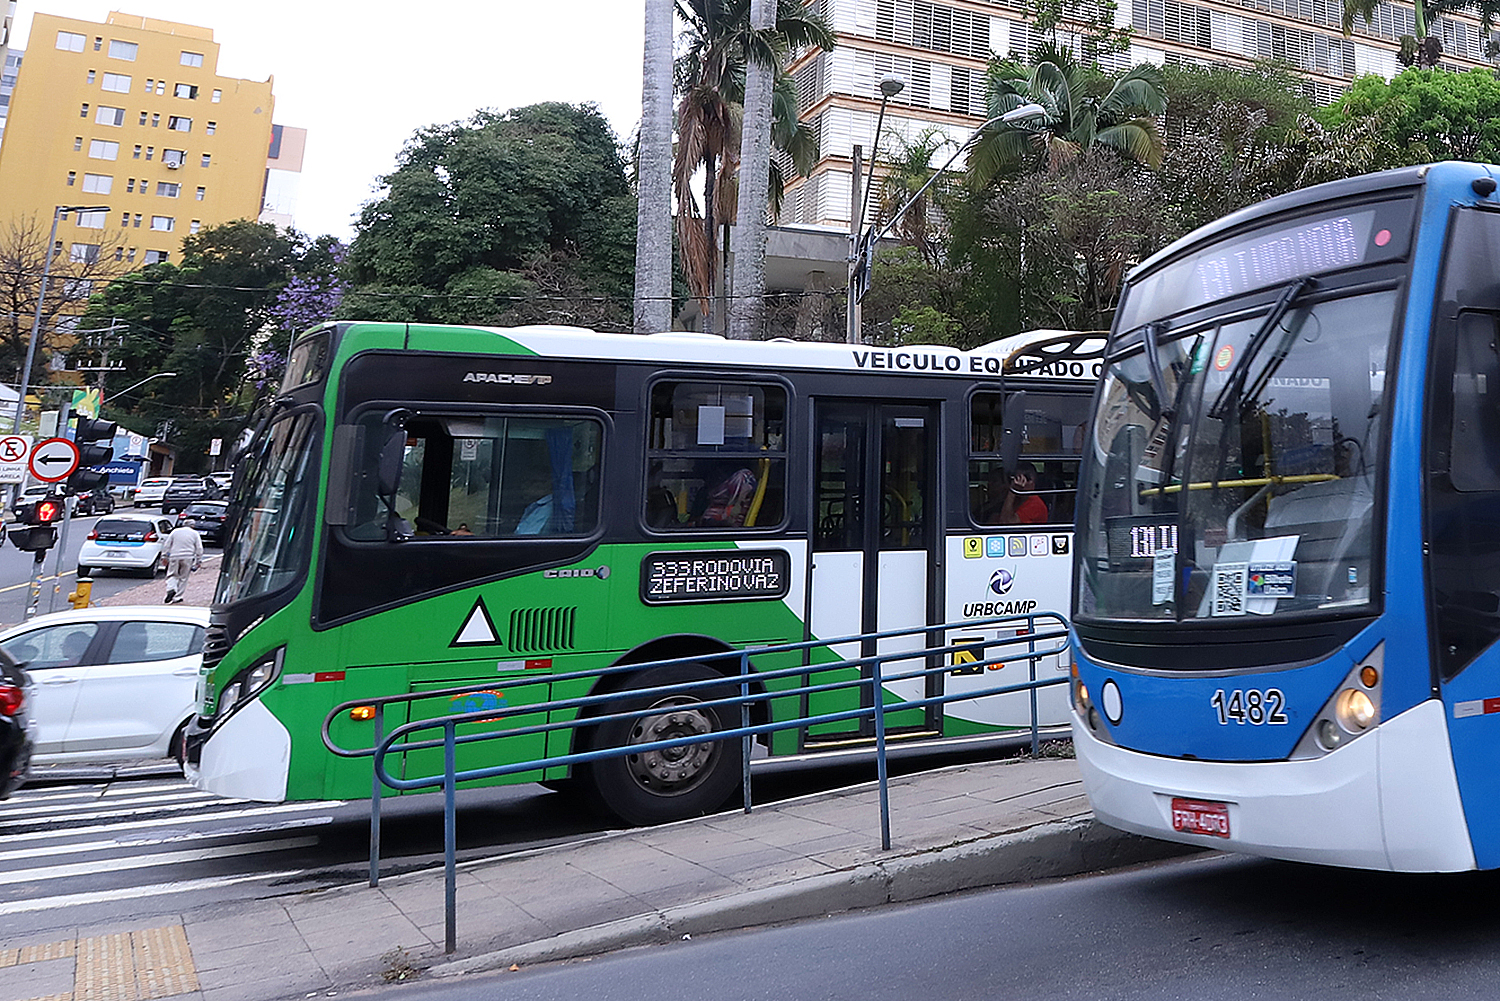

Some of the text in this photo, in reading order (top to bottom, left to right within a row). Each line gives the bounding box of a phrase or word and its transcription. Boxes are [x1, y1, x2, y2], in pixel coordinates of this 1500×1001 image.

[543, 568, 594, 578] CAIO
[653, 558, 774, 578] 333 RODOVIA
[650, 574, 779, 594] ZEFERINO VAZ
[963, 601, 1037, 617] URBCAMP
[1210, 688, 1289, 725] 1482
